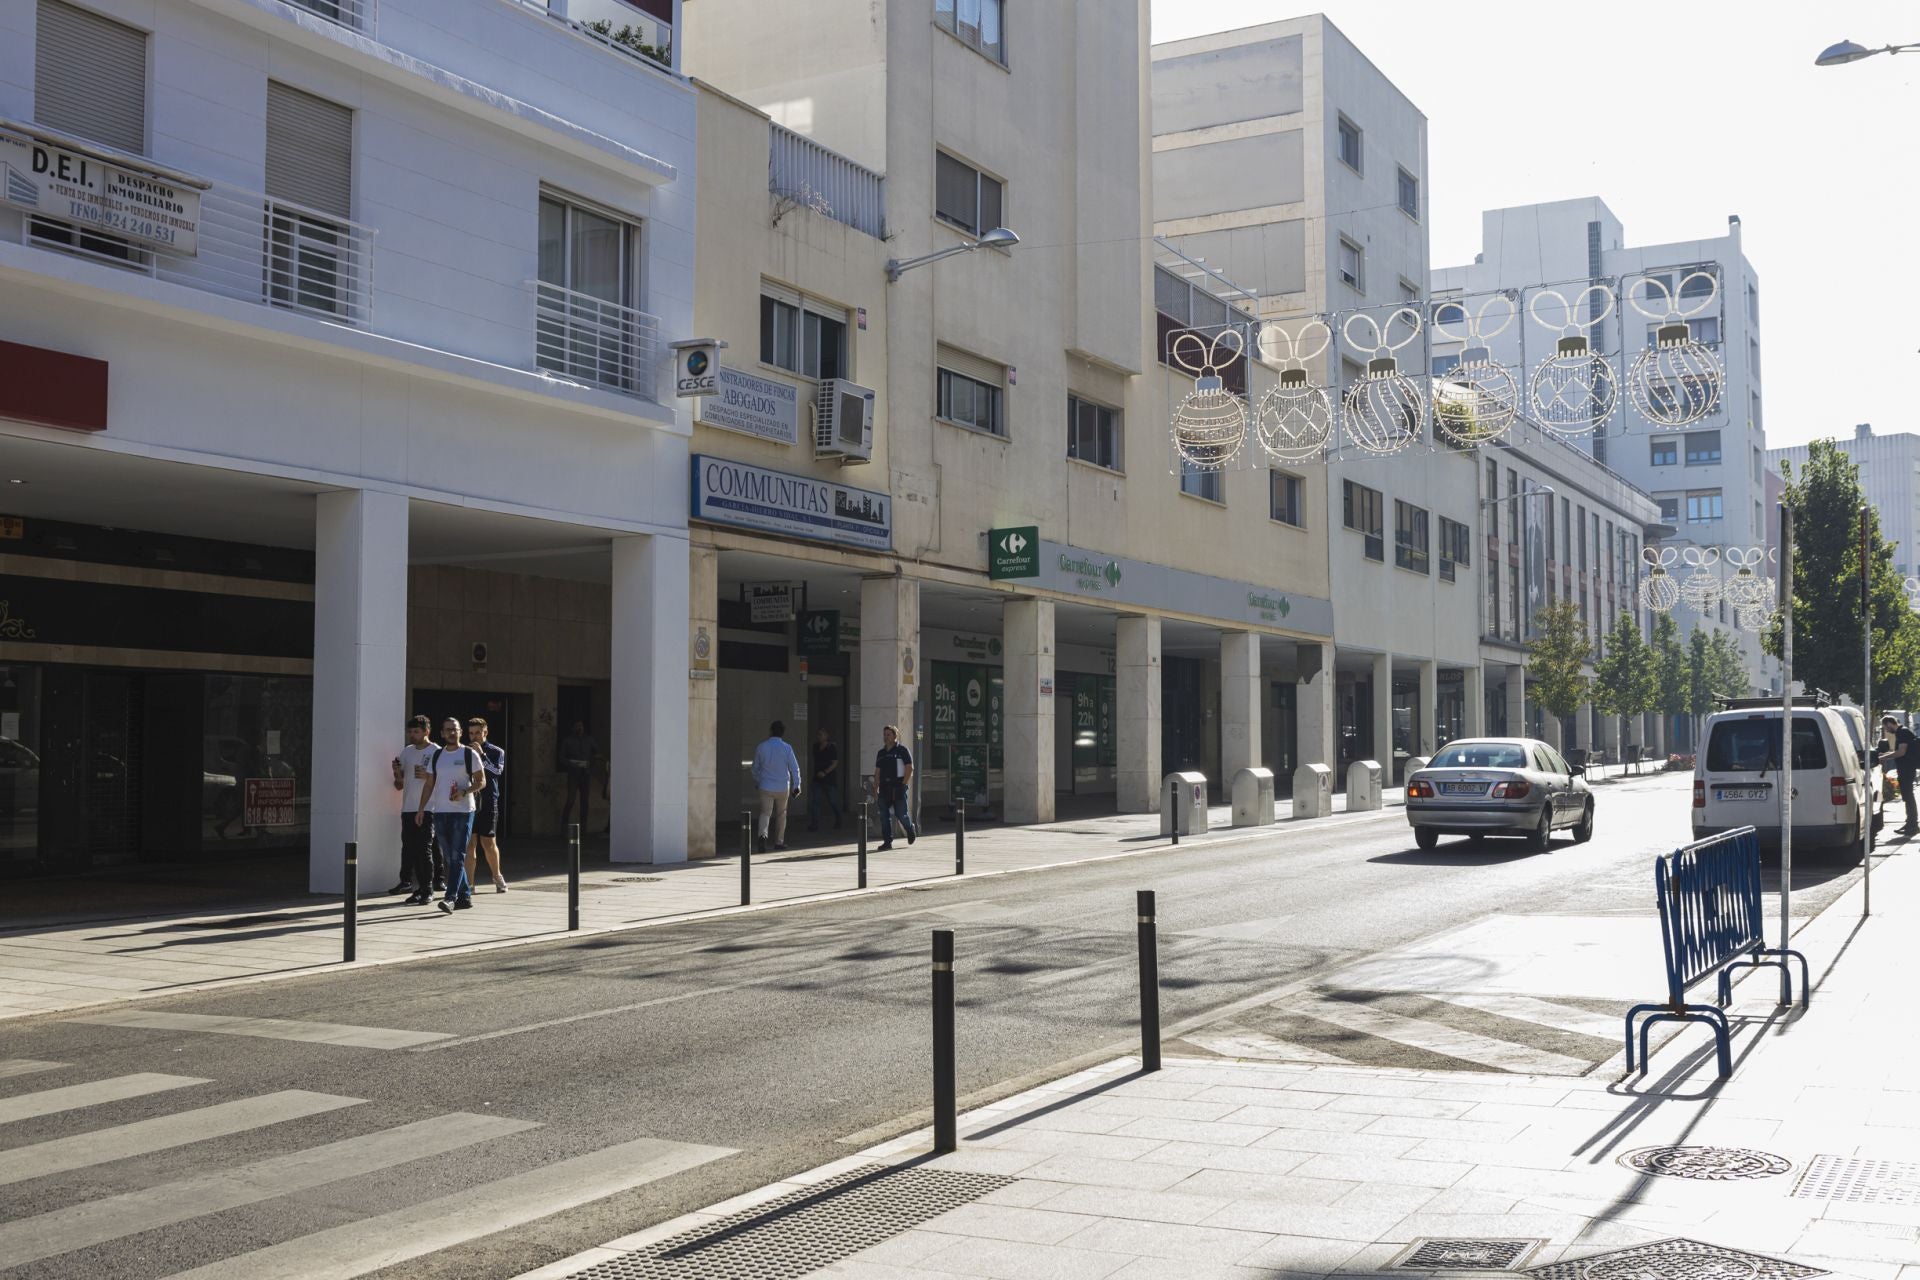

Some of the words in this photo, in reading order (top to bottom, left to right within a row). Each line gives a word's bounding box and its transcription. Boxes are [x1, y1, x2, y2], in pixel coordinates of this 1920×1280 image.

[32, 147, 93, 188] D.E.I.
[56, 184, 76, 198] VENTA
[77, 189, 86, 201] DE
[88, 191, 123, 211] INMUEBLES
[107, 184, 183, 214] INMOBILIARIO
[118, 174, 174, 199] DESPACHO
[105, 211, 126, 230] 924
[130, 218, 151, 236] 240
[154, 225, 176, 243] 531
[130, 205, 160, 222] VENDEMOS
[169, 215, 195, 232] INMUEBLE
[679, 376, 715, 391] CESCE
[764, 382, 772, 395] DE
[774, 385, 795, 401] FINCAS
[723, 389, 776, 415] ABOGADOS
[704, 412, 746, 429] COMUNIDADES
[755, 422, 792, 439] PROPIETARIOS
[709, 404, 738, 419] DESPACHO
[739, 410, 780, 429] ESPECIALIZADO
[782, 420, 789, 430] EN
[706, 463, 828, 514] COMMUNITAS
[997, 555, 1031, 565] Carrefour
[1001, 565, 1027, 573] express
[1060, 553, 1102, 577] Carrefour
[935, 684, 949, 701] 9h
[951, 691, 956, 701] a
[1077, 693, 1088, 708] 9h
[935, 705, 956, 722] 22h
[1078, 711, 1094, 726] 22h
